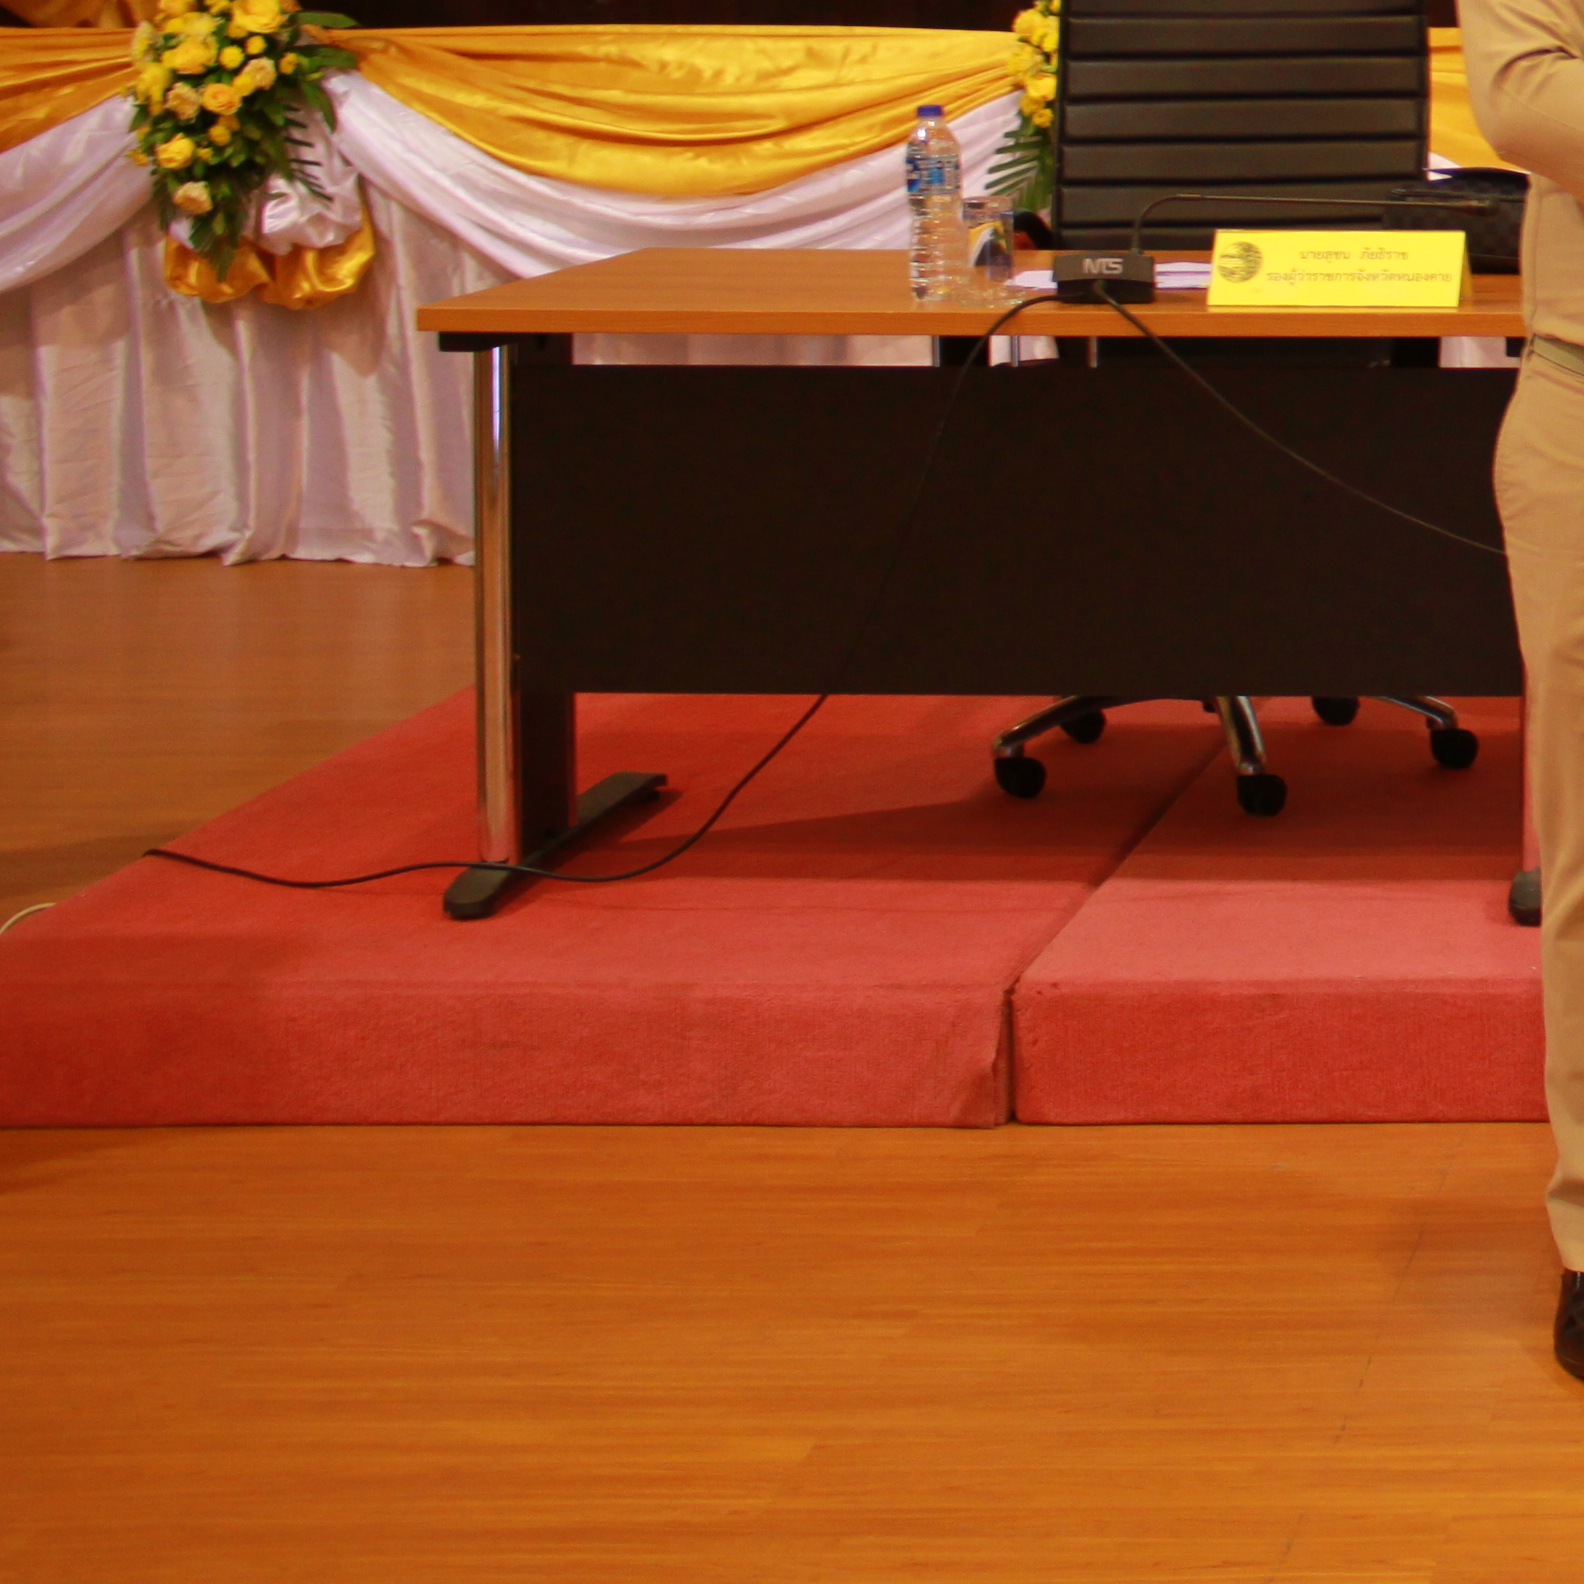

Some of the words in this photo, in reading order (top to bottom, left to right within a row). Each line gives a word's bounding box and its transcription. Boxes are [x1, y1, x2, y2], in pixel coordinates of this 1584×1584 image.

[1265, 268, 1453, 286] รองผู้ว่าราชการจังหวัดหนองคาย
